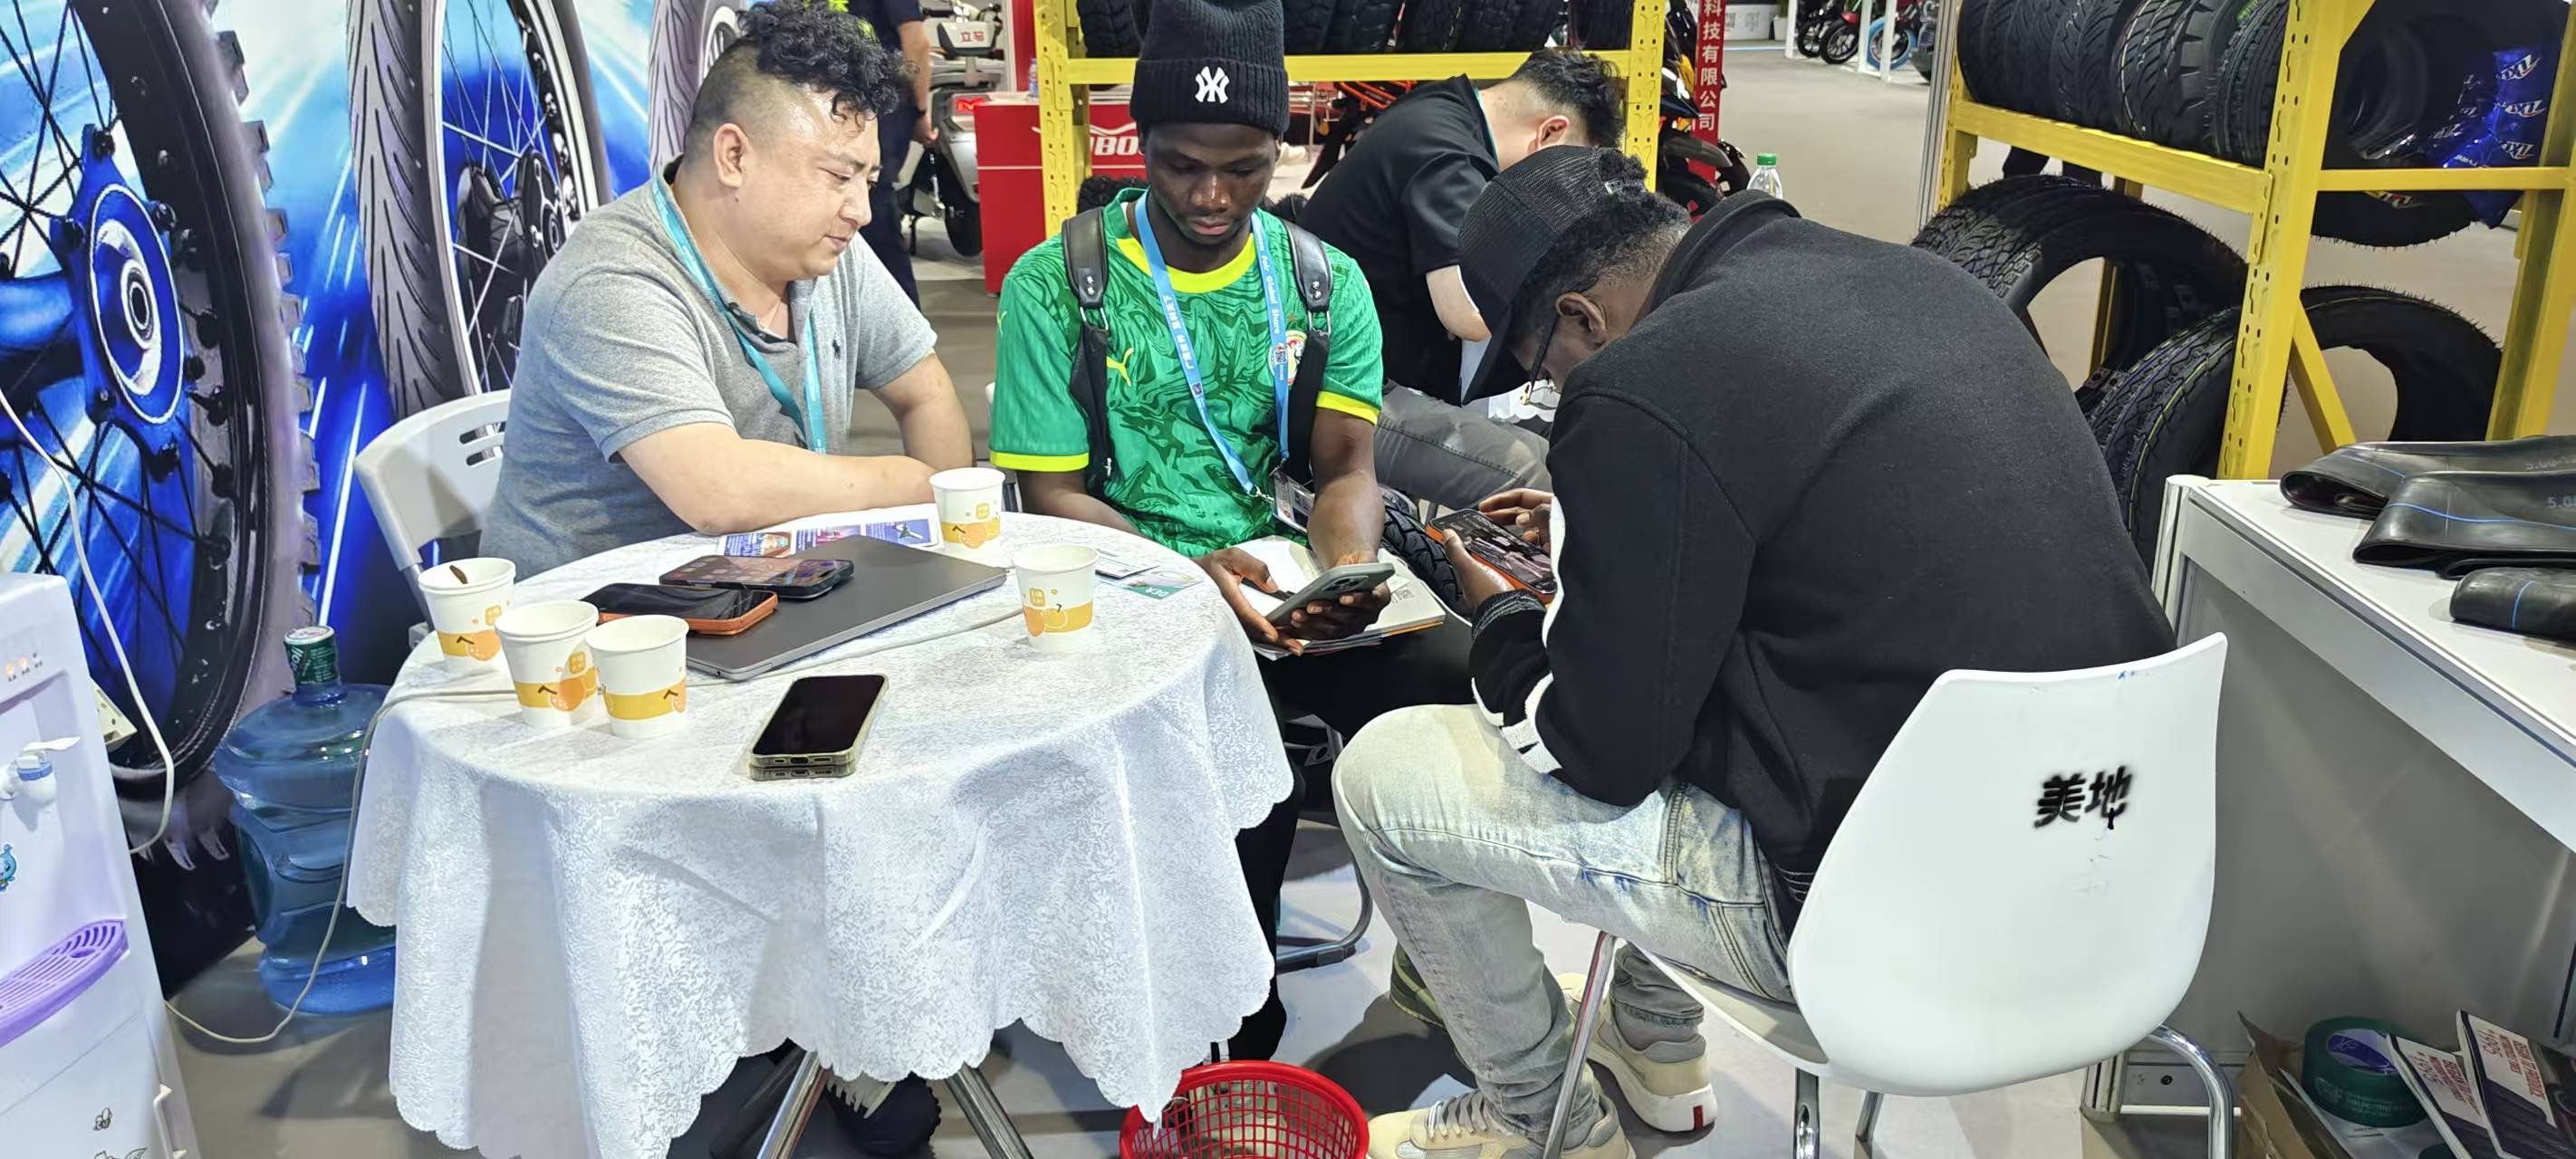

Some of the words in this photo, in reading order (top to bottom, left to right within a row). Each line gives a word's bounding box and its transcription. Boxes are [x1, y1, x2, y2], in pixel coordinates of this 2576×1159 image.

[1699, 0, 1721, 131] 科技有限公司
[1090, 136, 1145, 156] BO
[1266, 276, 1278, 304] Global
[1272, 309, 1280, 334] Share
[2033, 765, 2133, 830] 美地
